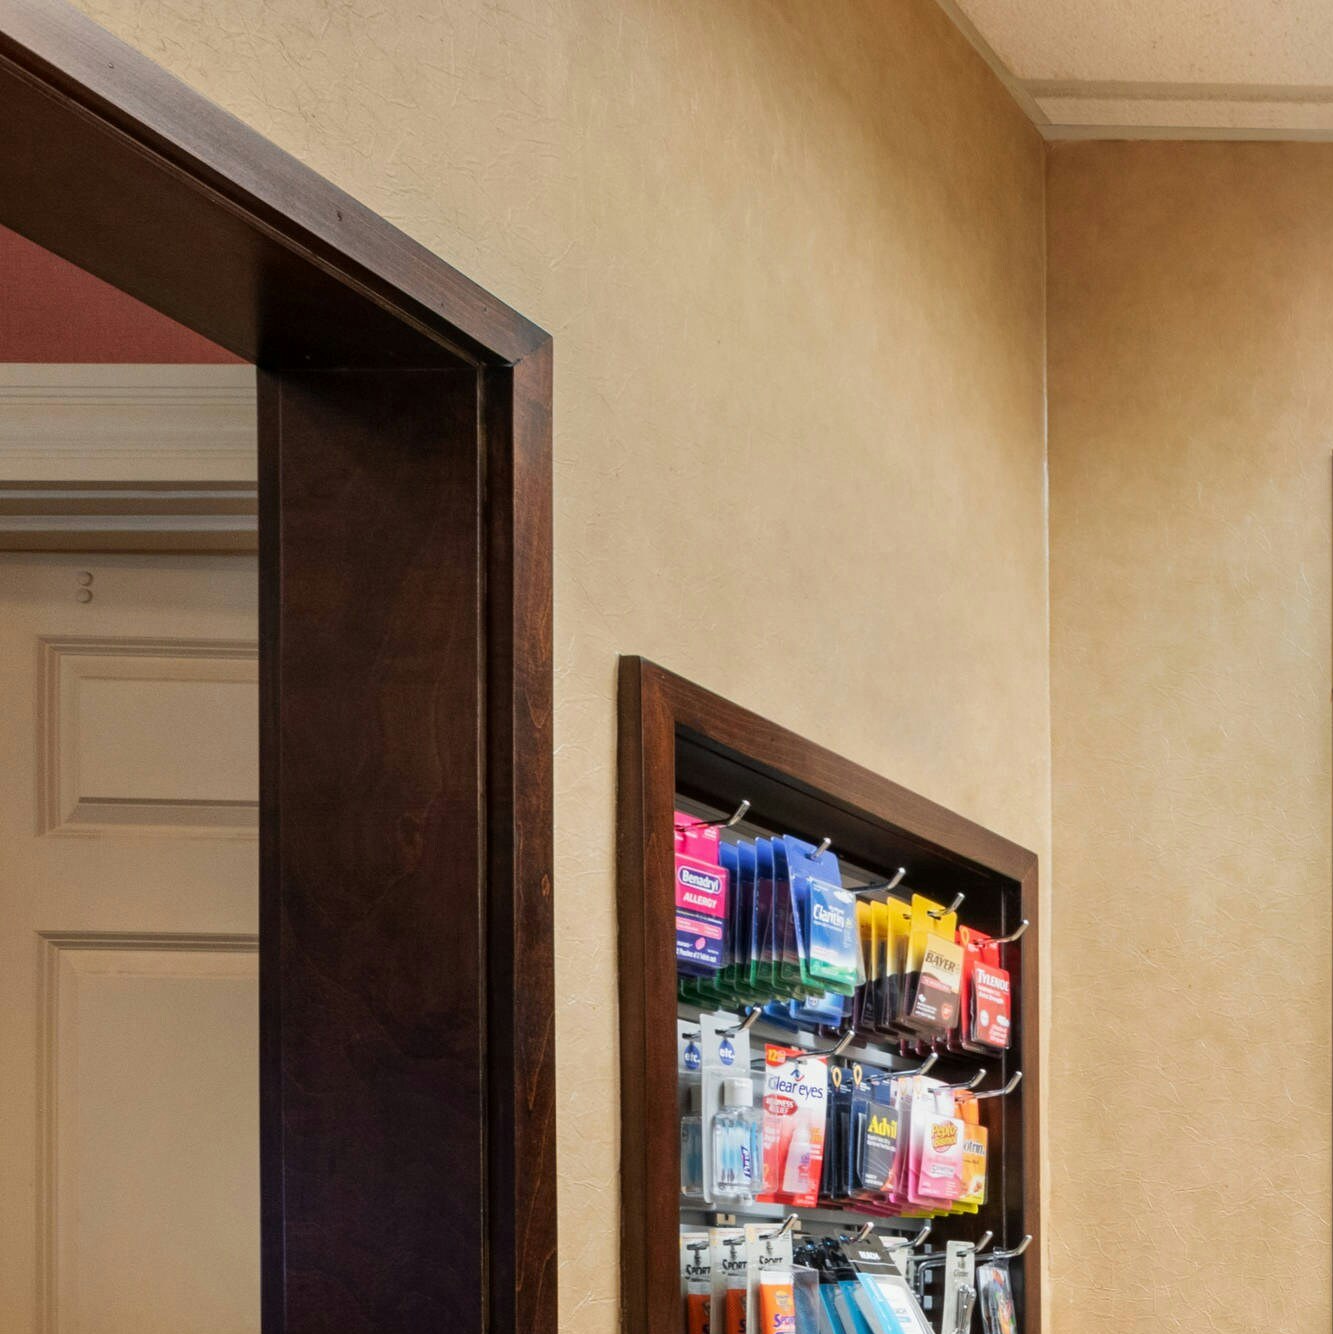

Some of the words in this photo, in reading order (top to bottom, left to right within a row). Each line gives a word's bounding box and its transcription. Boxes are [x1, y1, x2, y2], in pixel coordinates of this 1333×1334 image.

[681, 867, 719, 891] Benadryl
[683, 891, 717, 908] ALLERGY
[925, 952, 956, 972] BAYER
[976, 968, 1009, 992] TYLENOL
[798, 1084, 824, 1101] eyes
